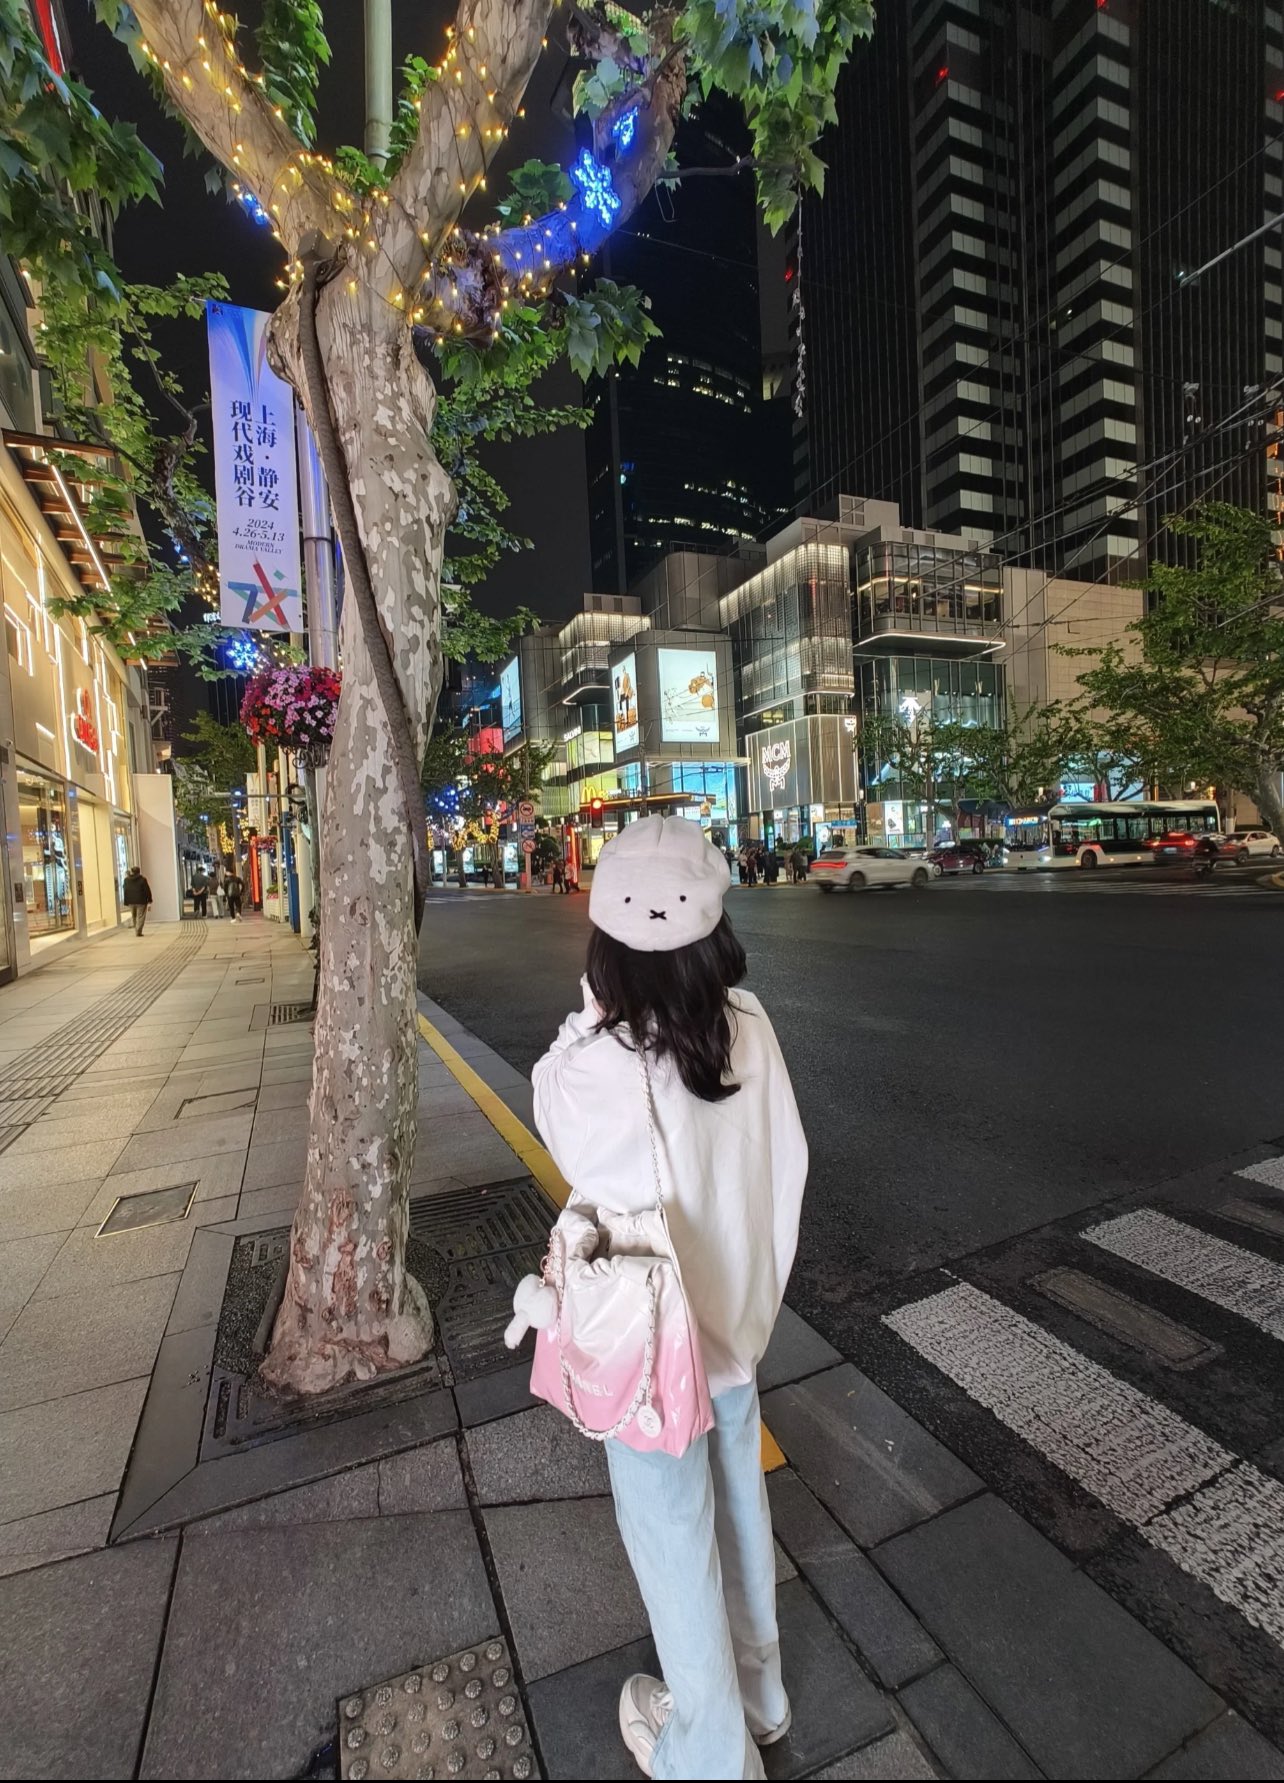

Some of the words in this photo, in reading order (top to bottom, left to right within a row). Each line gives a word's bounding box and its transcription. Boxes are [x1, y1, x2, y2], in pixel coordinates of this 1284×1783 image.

[231, 400, 255, 507] 现代戏剧谷
[247, 518, 274, 530] 2024
[762, 740, 791, 763] MCM
